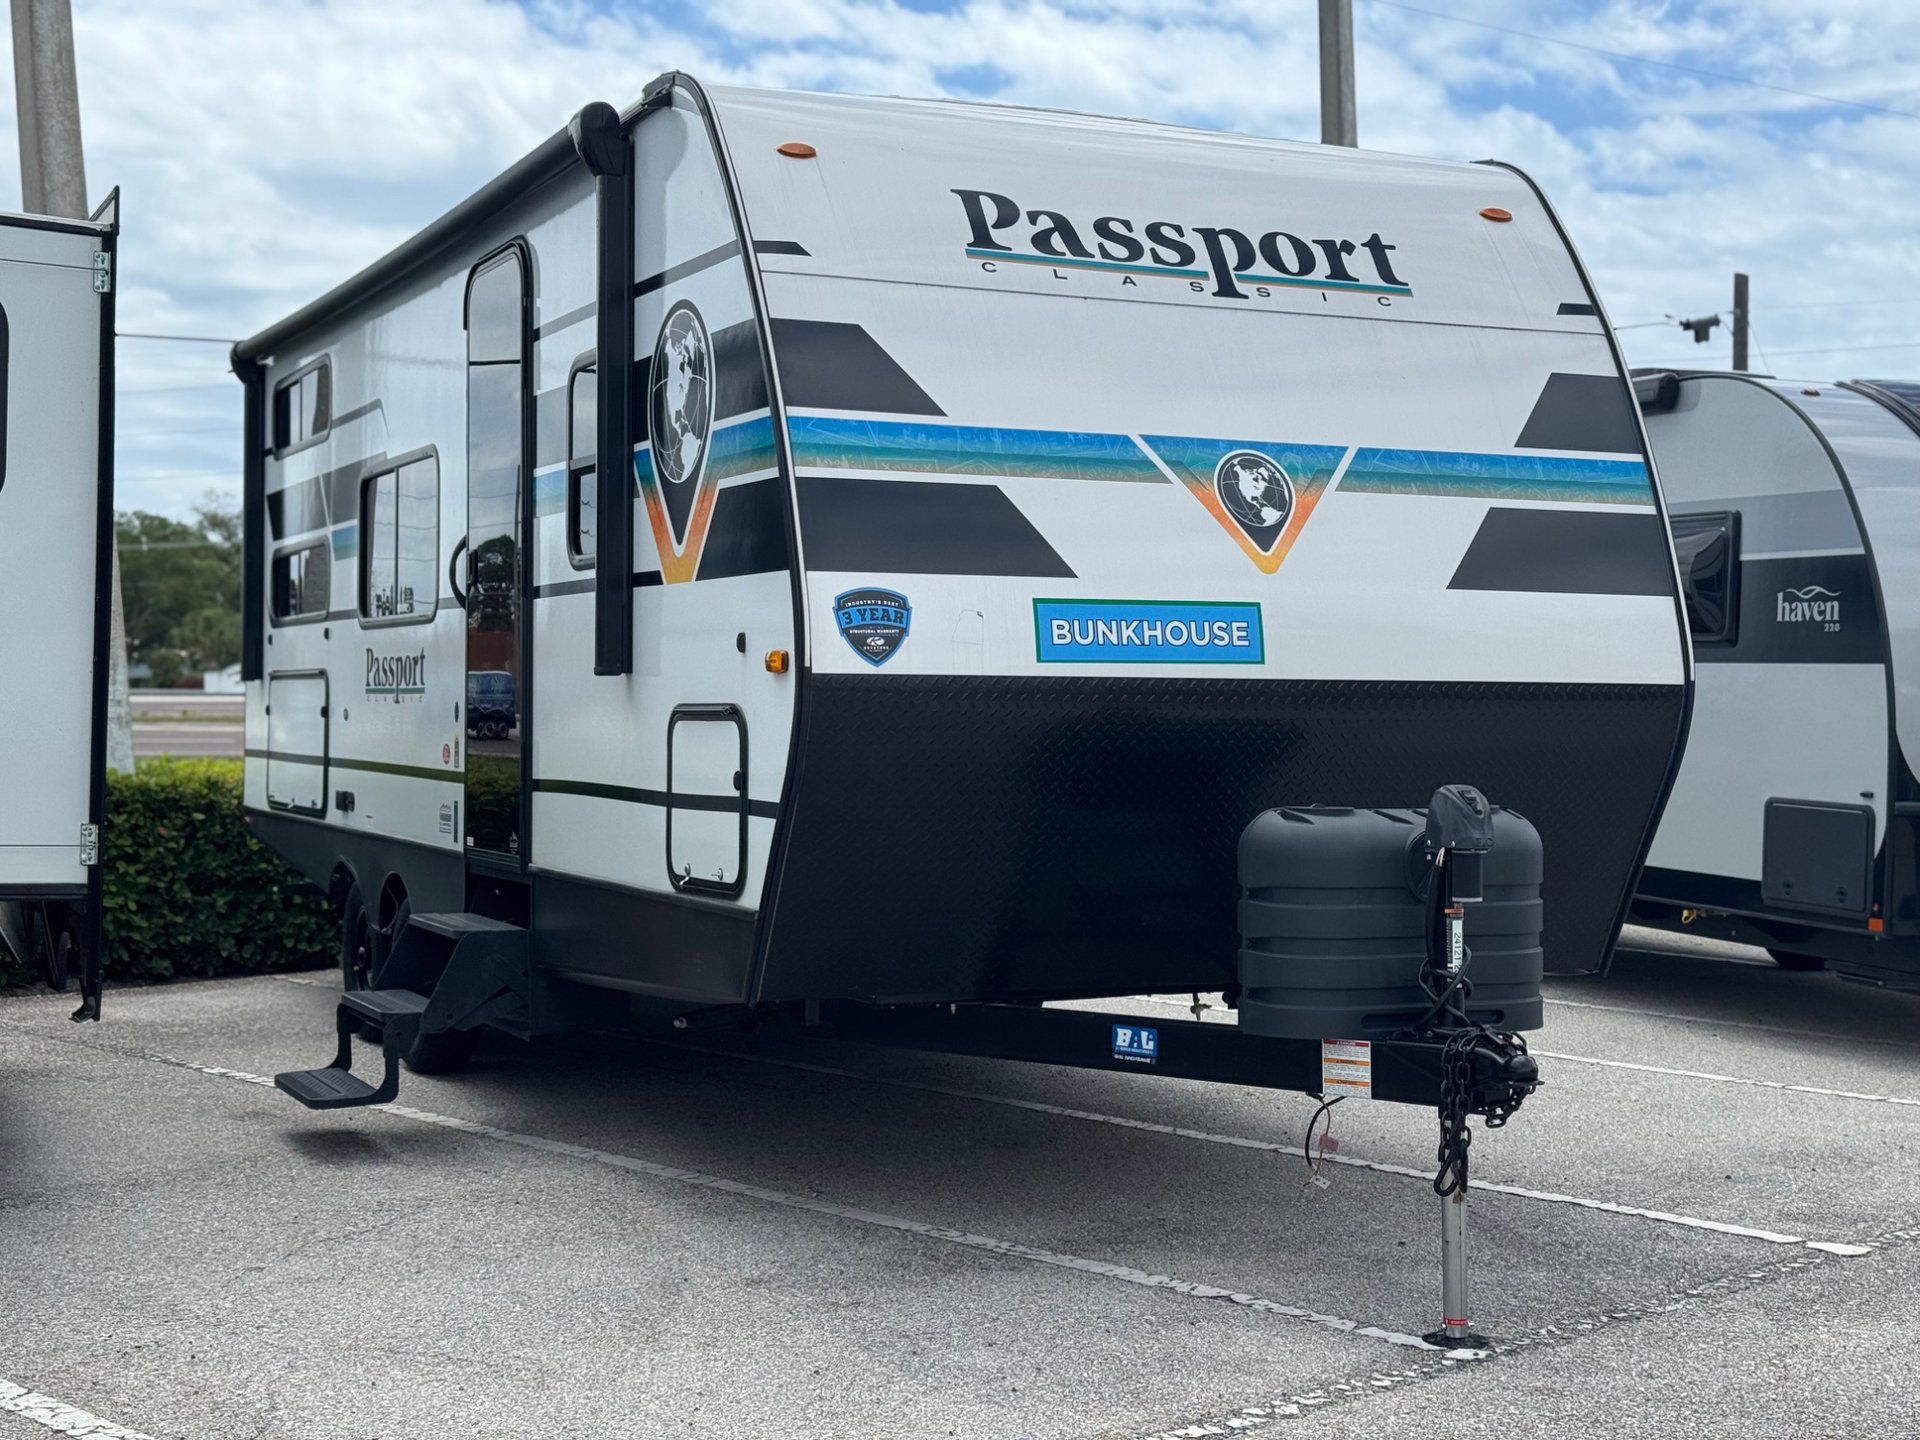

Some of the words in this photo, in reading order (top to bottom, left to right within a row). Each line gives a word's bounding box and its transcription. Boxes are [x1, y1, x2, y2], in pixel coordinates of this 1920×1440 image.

[950, 188, 1410, 299] Passport
[981, 262, 1393, 307] CLASSIC
[842, 611, 853, 625] 3
[856, 607, 904, 624] YEAR
[1776, 592, 1840, 622] haven
[1051, 619, 1251, 647] BUNKHOUSE
[1824, 623, 1840, 632] 220
[366, 647, 425, 704] Passport
